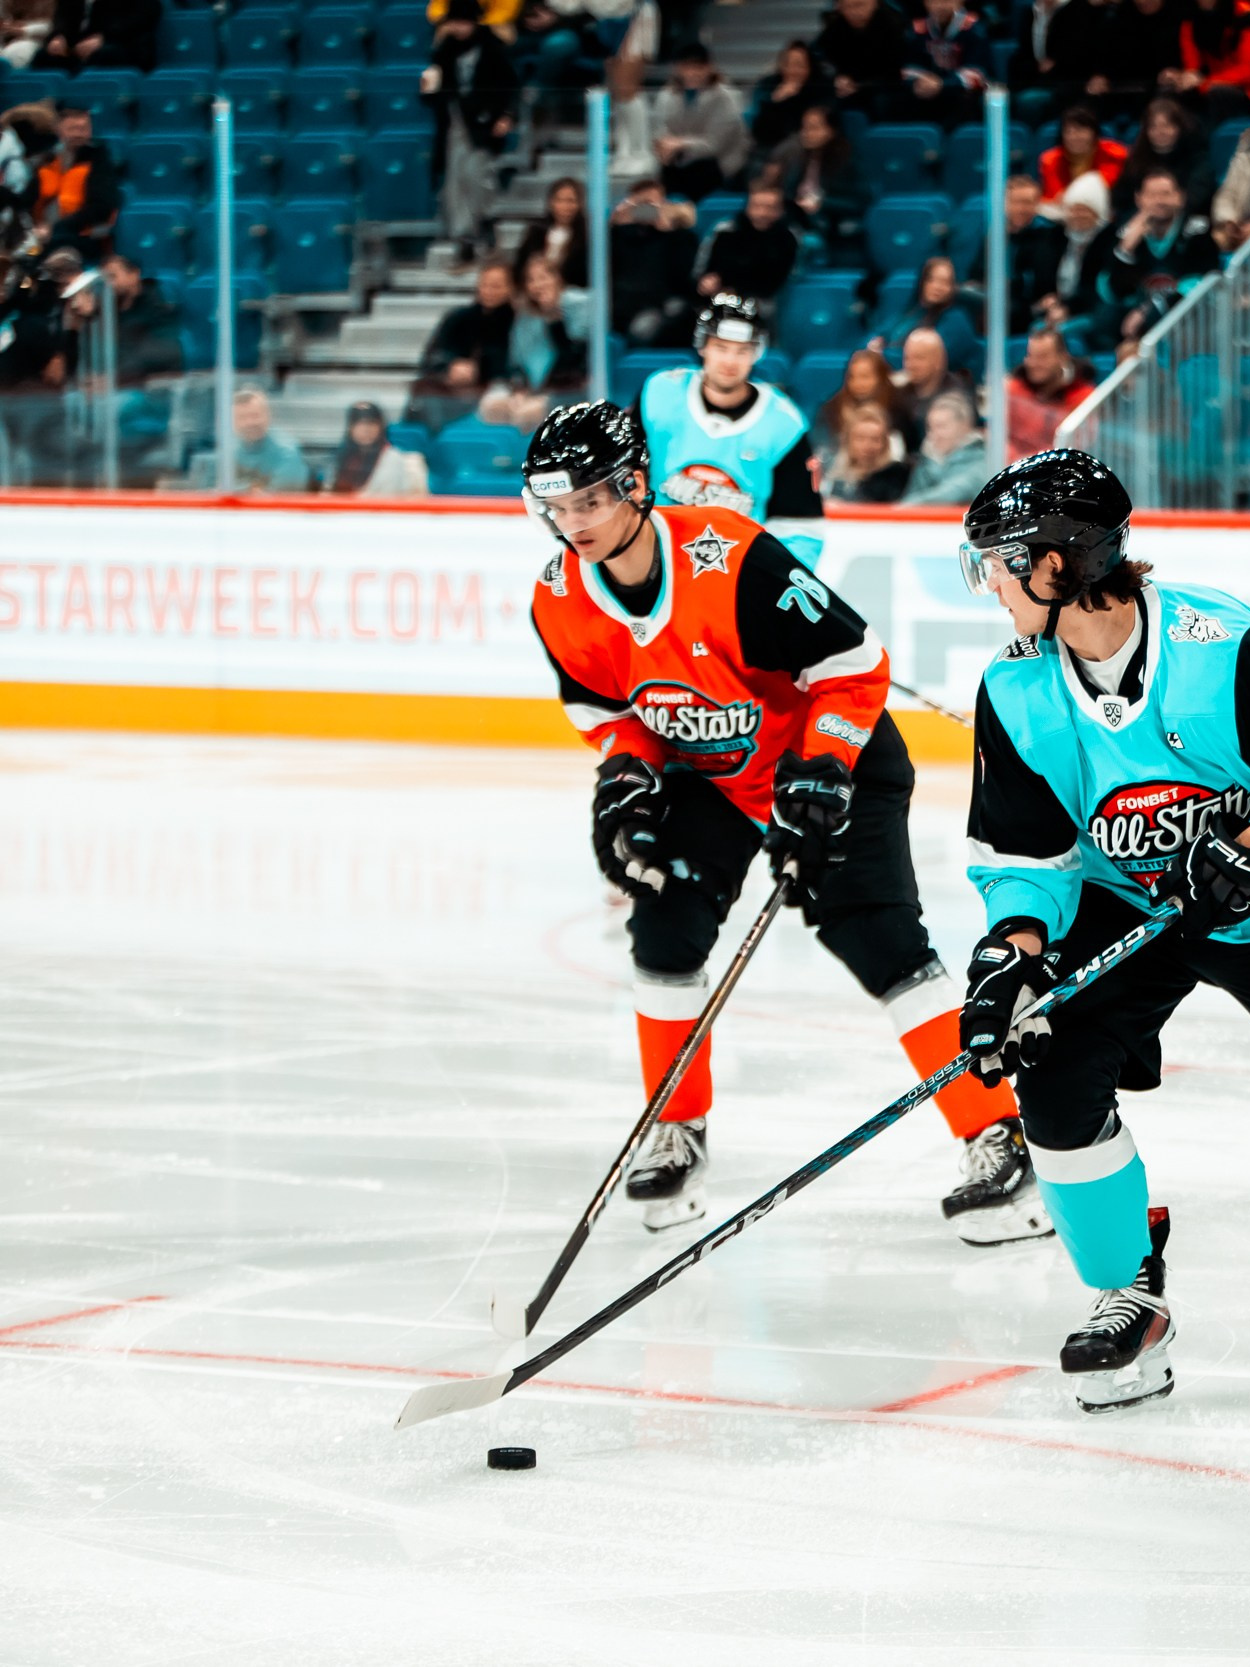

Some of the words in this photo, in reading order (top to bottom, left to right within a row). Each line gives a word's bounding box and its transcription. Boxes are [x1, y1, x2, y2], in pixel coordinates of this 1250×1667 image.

[999, 526, 1039, 541] TRUE
[776, 567, 829, 624] 78
[645, 692, 694, 704] FONBET
[1116, 787, 1179, 811] FONBET
[1120, 860, 1136, 871] ST.
[1074, 924, 1146, 984] CCM
[907, 1050, 972, 1100] ETSPEED
